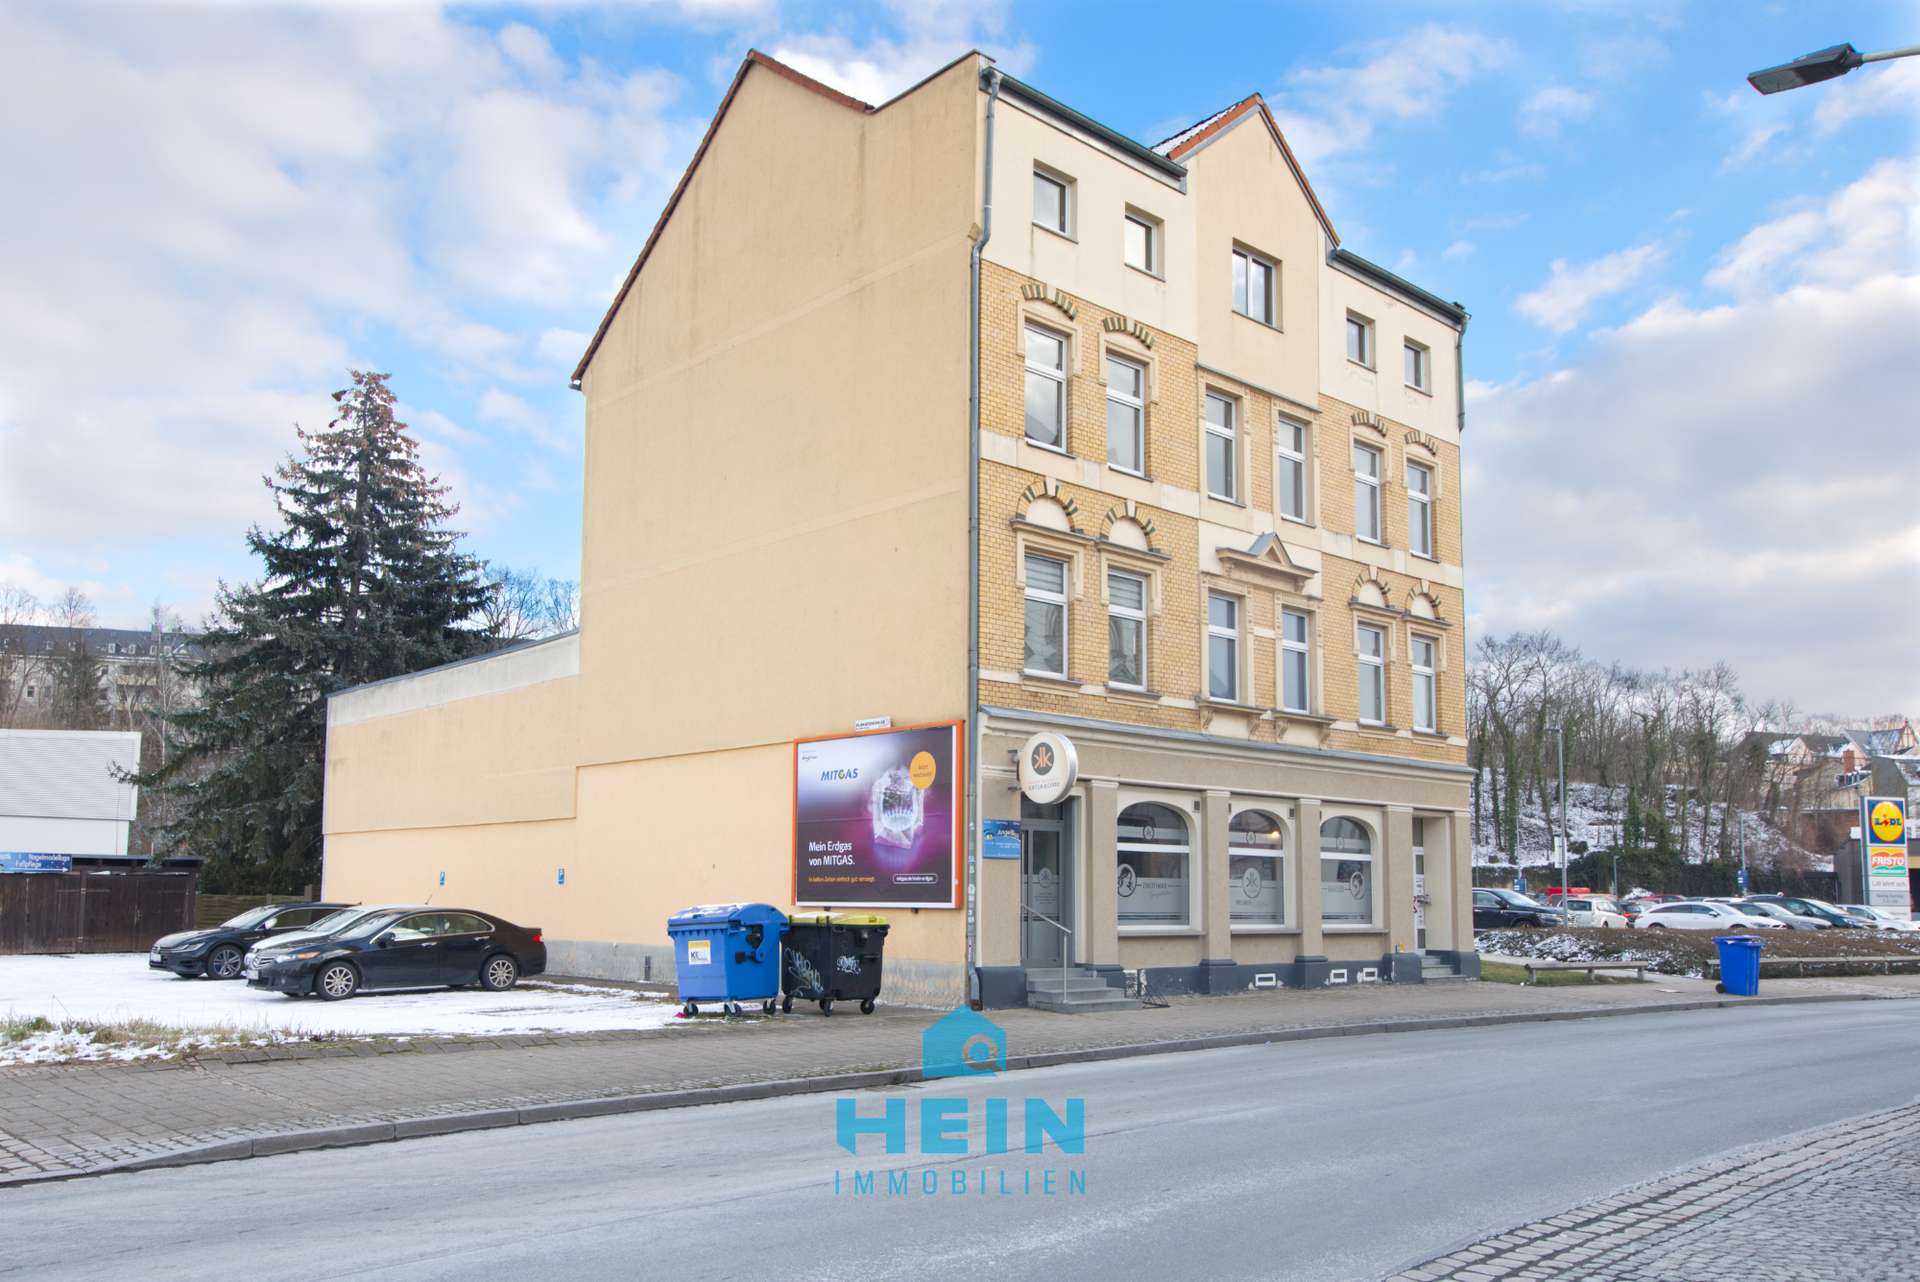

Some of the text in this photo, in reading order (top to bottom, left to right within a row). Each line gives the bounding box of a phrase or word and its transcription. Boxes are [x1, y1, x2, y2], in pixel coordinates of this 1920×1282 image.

[821, 768, 858, 781] MITGAS
[1875, 816, 1902, 826] LIDL
[809, 840, 852, 853] Mein Erdgas
[809, 854, 855, 866] von MITGAS.
[1871, 856, 1905, 866] FRISTO
